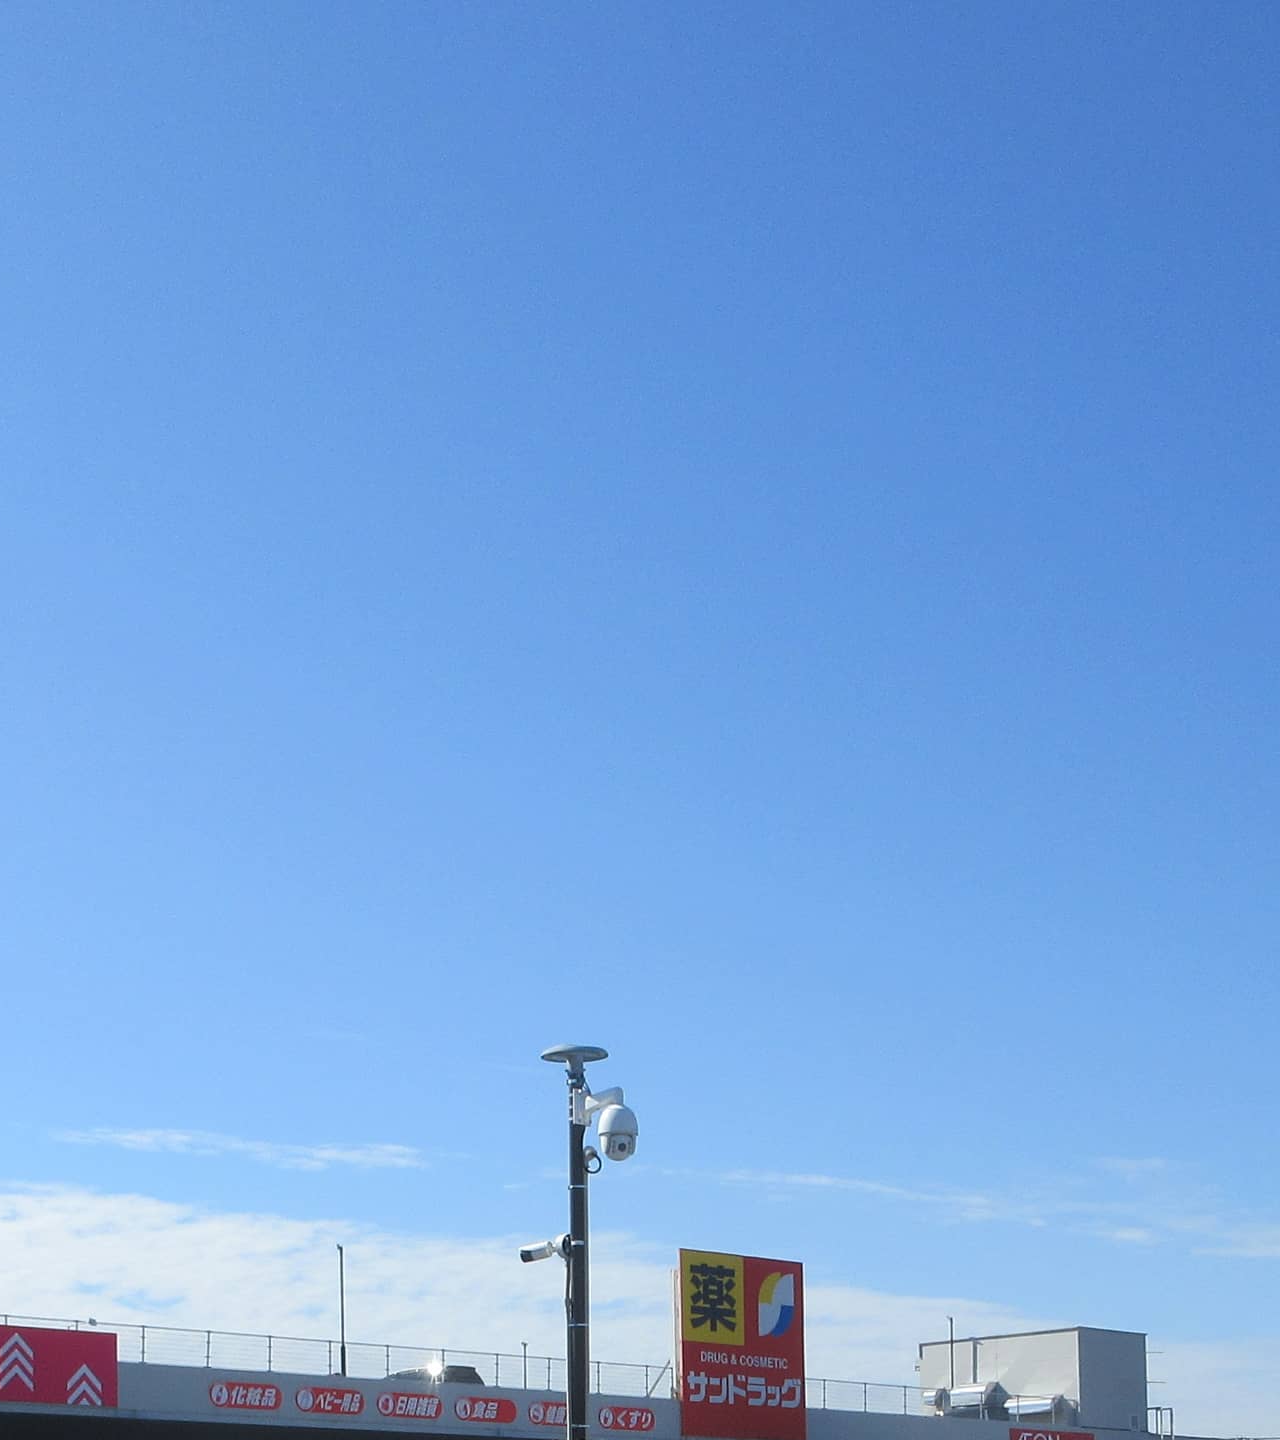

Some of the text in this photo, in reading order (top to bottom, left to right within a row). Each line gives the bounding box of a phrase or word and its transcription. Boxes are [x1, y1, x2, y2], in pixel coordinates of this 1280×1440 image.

[690, 1263, 737, 1332] 薬
[700, 1351, 788, 1369] DRUG & COSMETIC
[230, 1385, 277, 1407] 化粧品
[687, 1370, 802, 1409] サンドラッグ
[472, 1402, 498, 1419] 食品
[616, 1410, 652, 1428] くすり
